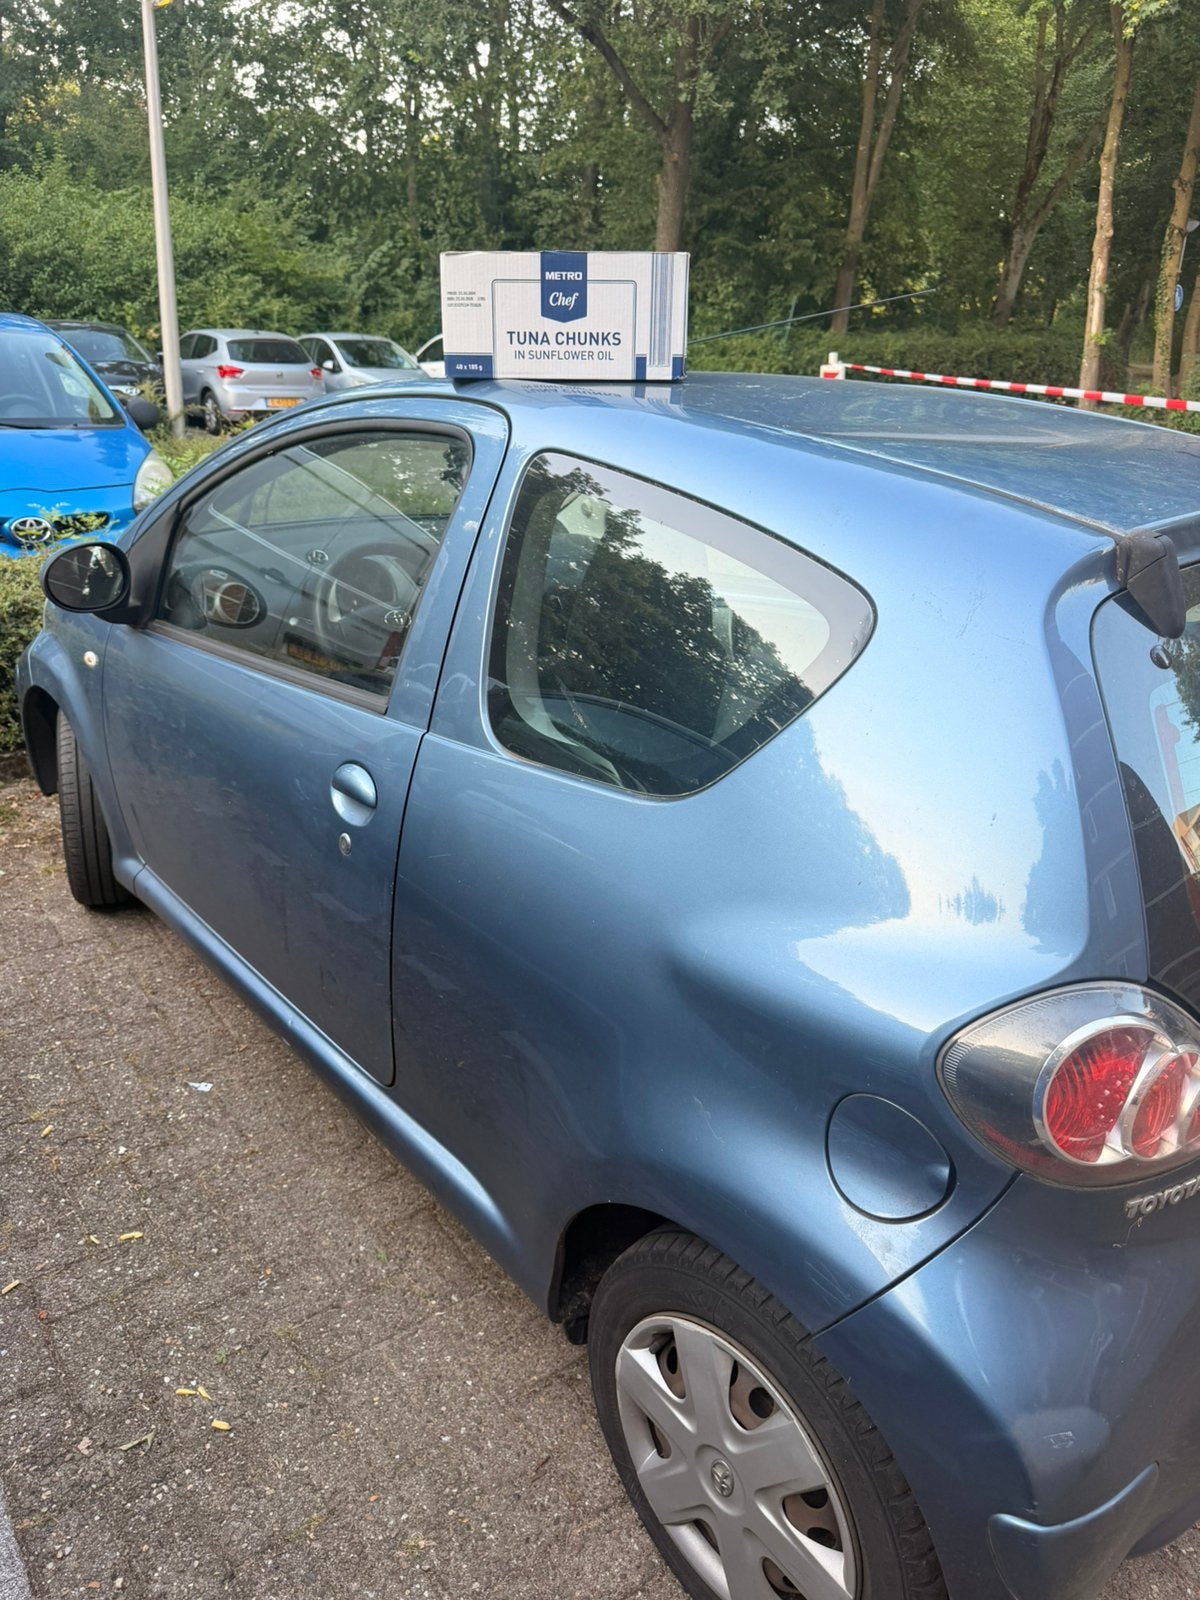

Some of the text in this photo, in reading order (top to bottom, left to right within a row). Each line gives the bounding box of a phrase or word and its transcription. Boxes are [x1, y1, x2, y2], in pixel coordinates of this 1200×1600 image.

[545, 271, 582, 280] METRO
[549, 291, 579, 310] Chef
[507, 331, 621, 346] TUNA CHUNKS
[514, 350, 614, 361] IN SUNFLOWER OIL
